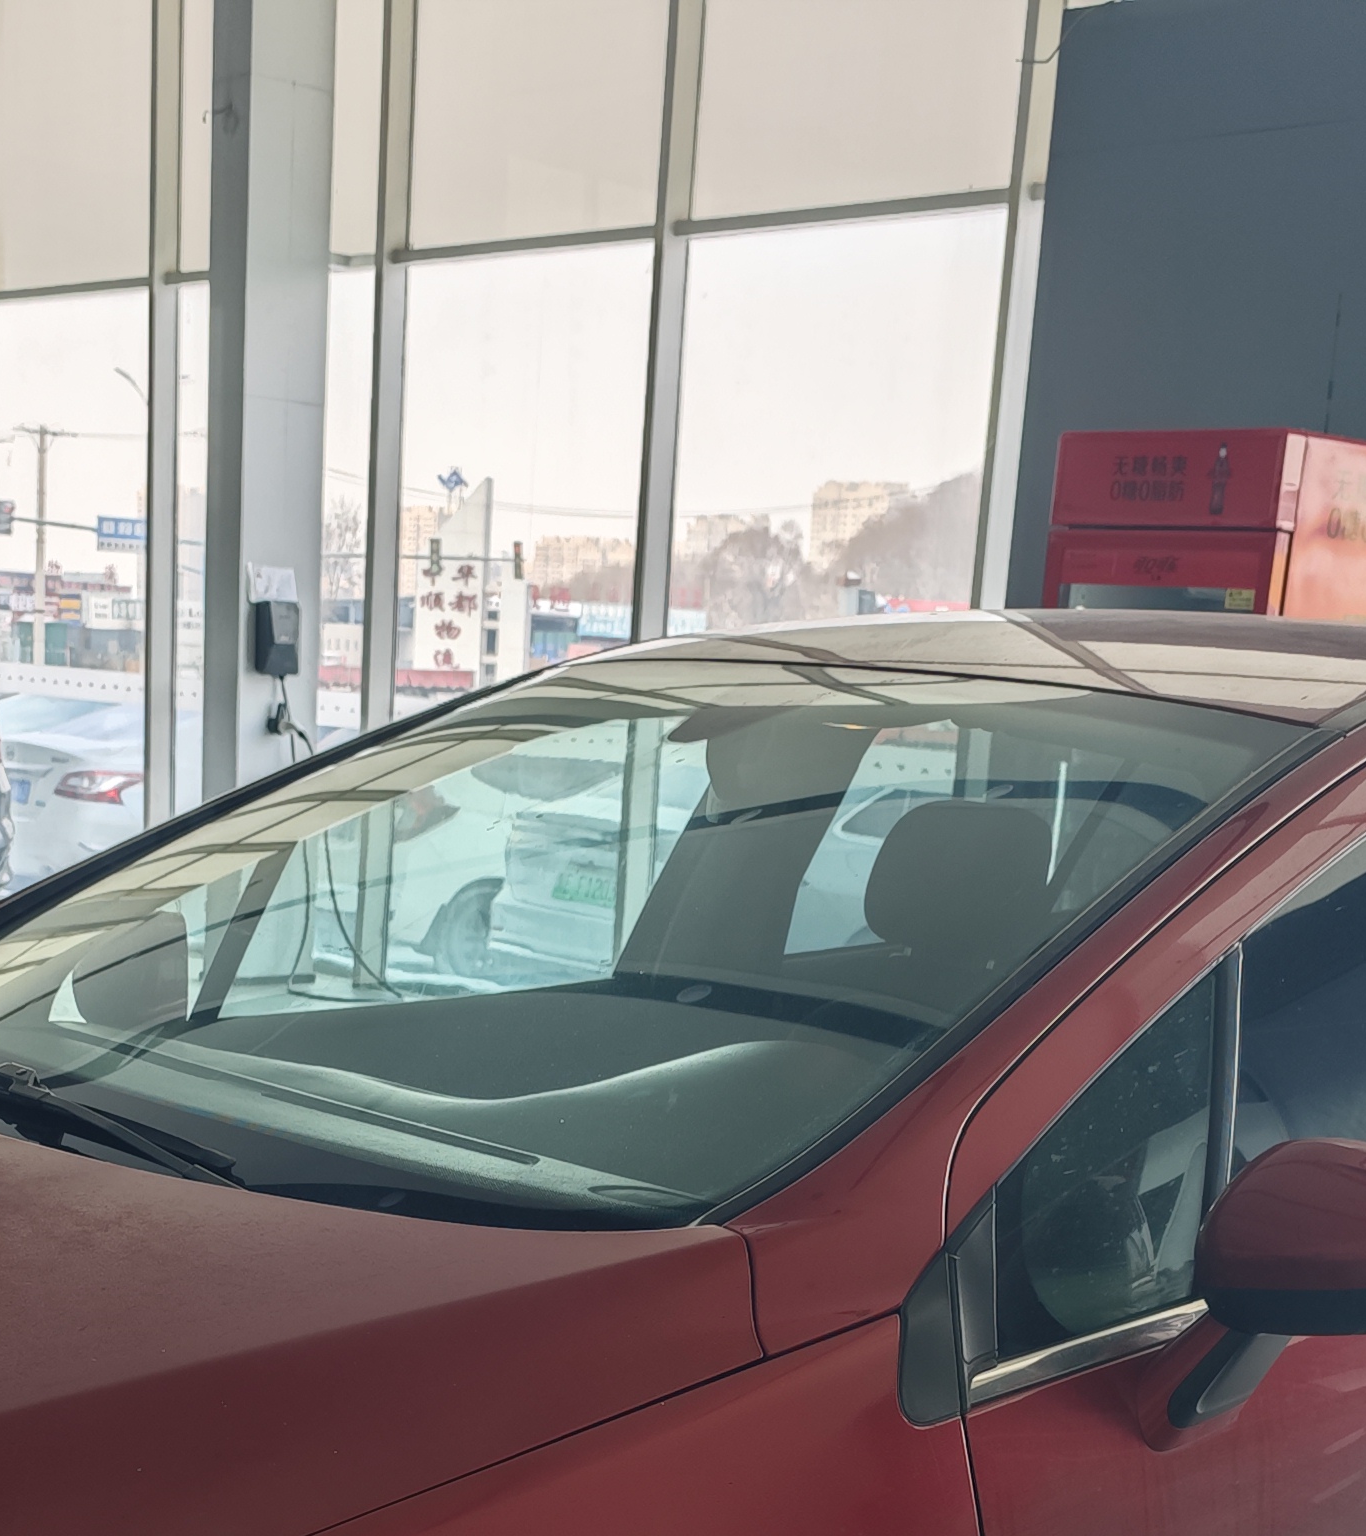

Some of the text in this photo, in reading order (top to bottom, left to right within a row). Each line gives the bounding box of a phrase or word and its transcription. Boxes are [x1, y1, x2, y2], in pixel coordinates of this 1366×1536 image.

[1112, 454, 1188, 478] 无糖畅爽
[1110, 480, 1185, 502] 0糖0脂肪
